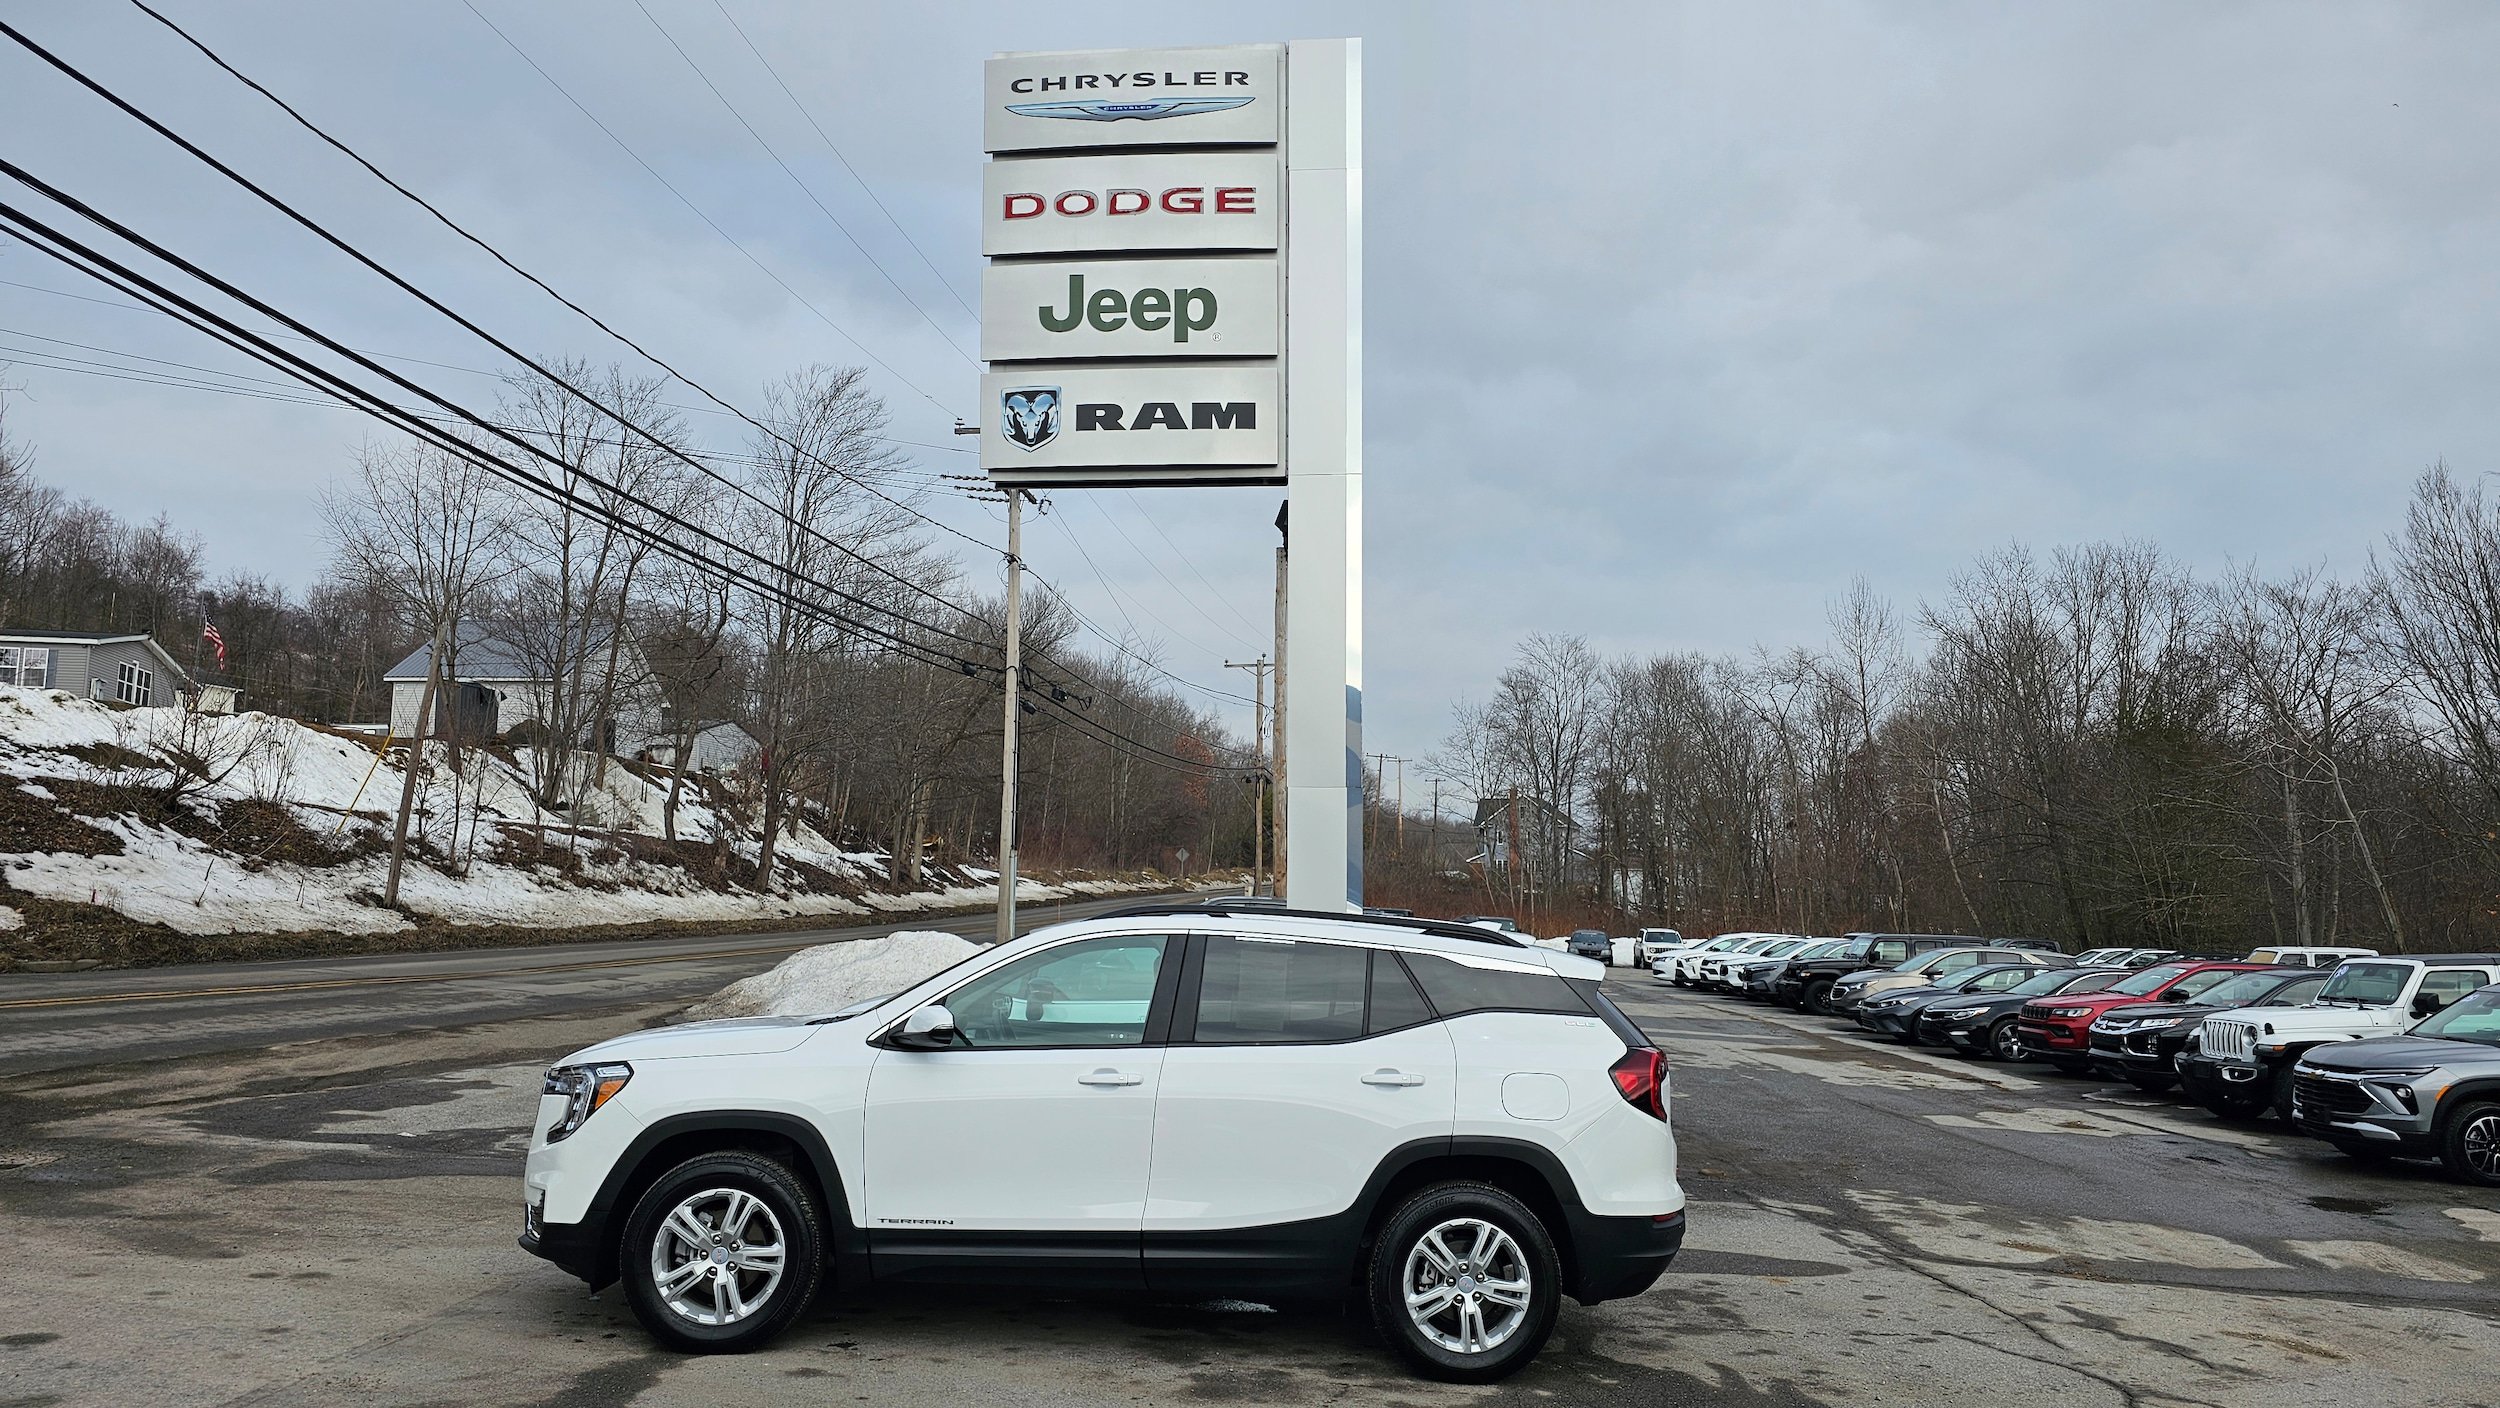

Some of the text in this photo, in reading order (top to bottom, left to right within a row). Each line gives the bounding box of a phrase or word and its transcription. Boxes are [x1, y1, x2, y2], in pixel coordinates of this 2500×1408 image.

[1010, 71, 1249, 94] CHRYSLER
[1002, 187, 1257, 221] DODGE
[1038, 274, 1218, 343] Jeep
[1075, 402, 1256, 431] RAM
